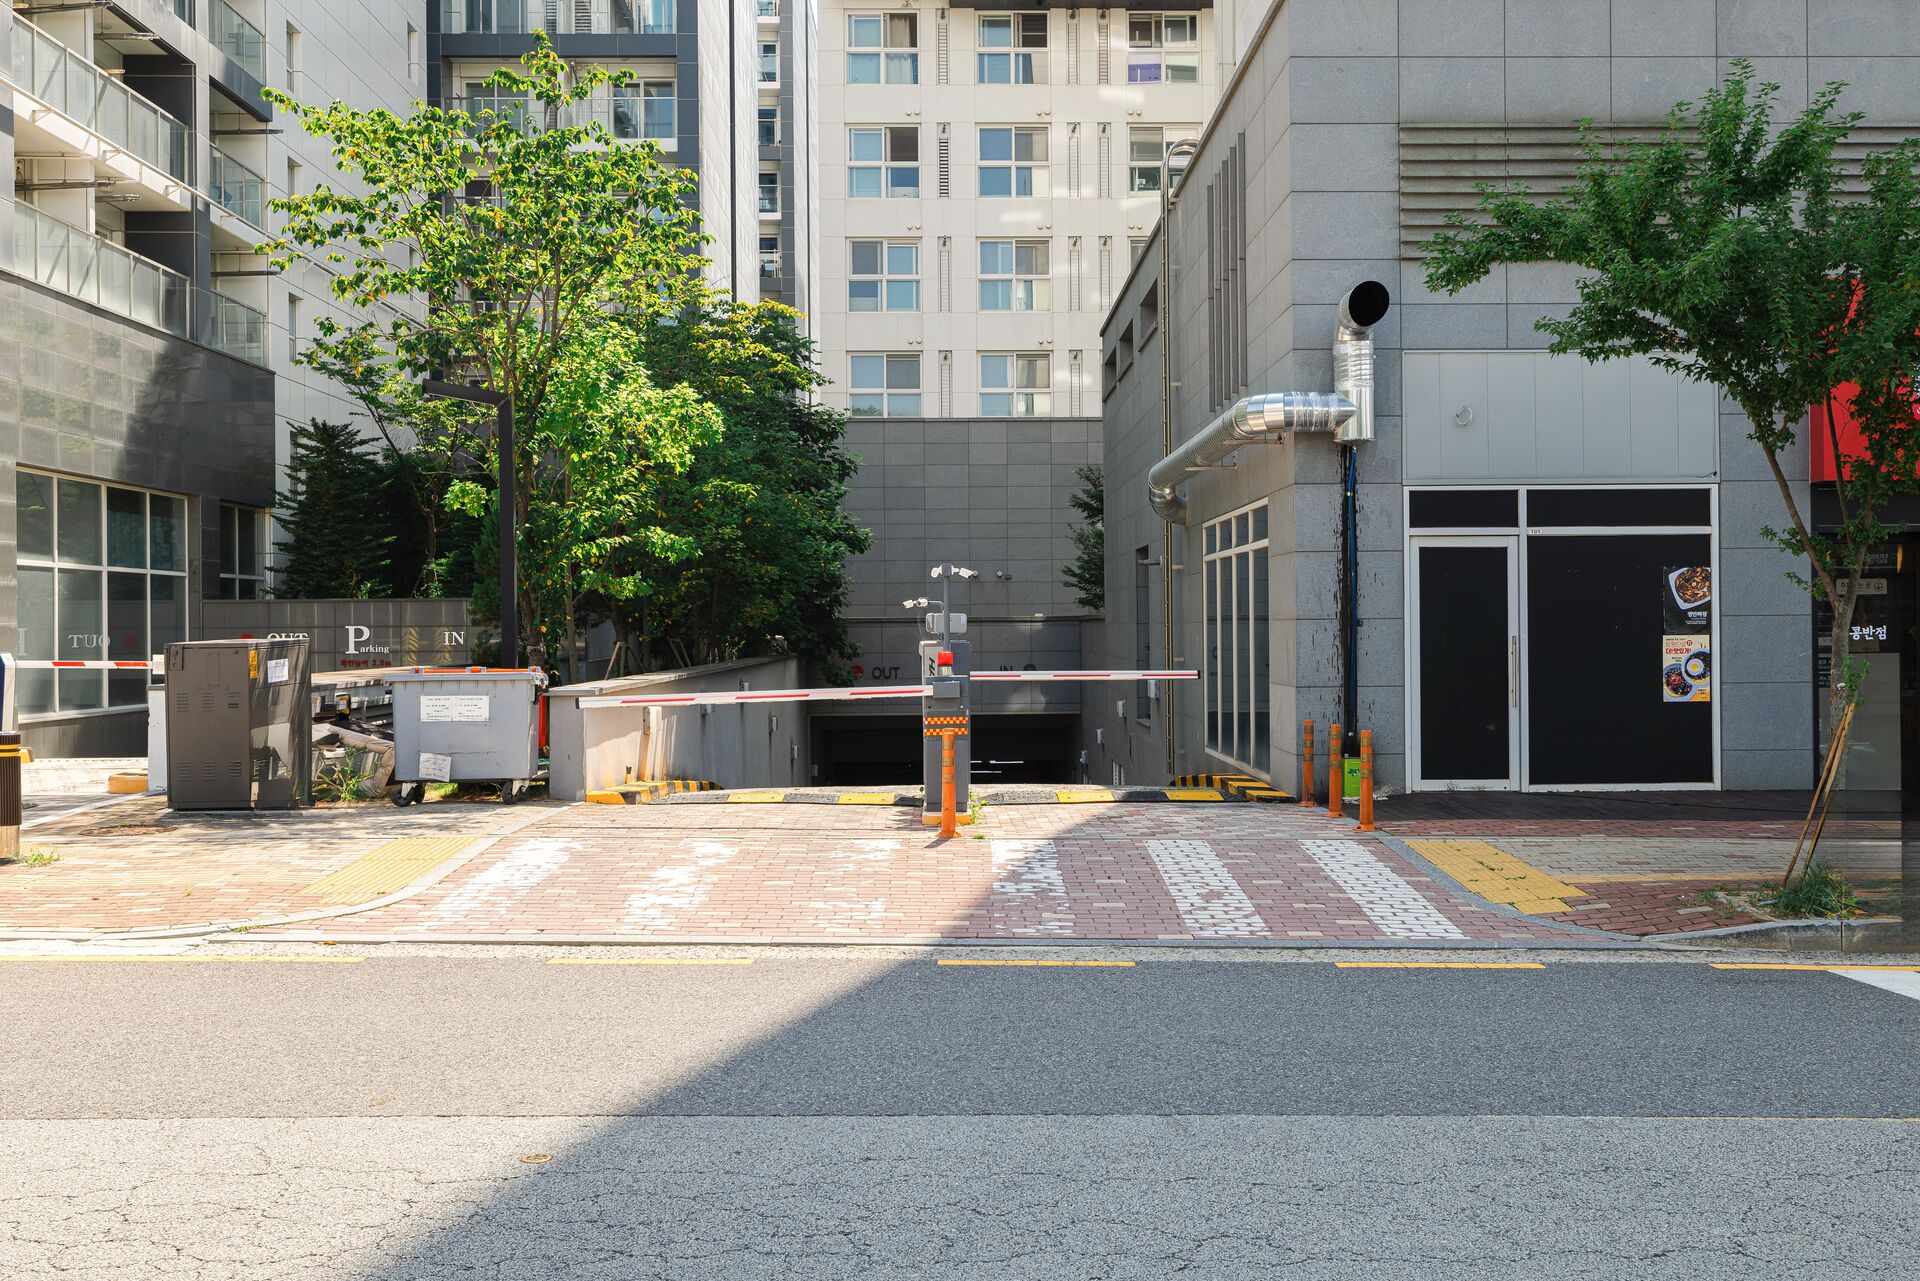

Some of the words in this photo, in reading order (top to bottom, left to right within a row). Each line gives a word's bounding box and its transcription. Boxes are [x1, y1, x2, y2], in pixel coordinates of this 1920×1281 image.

[345, 625, 390, 654] Parking
[443, 631, 465, 646] IN
[1849, 625, 1887, 641] 콩반점
[871, 666, 900, 680] OUT
